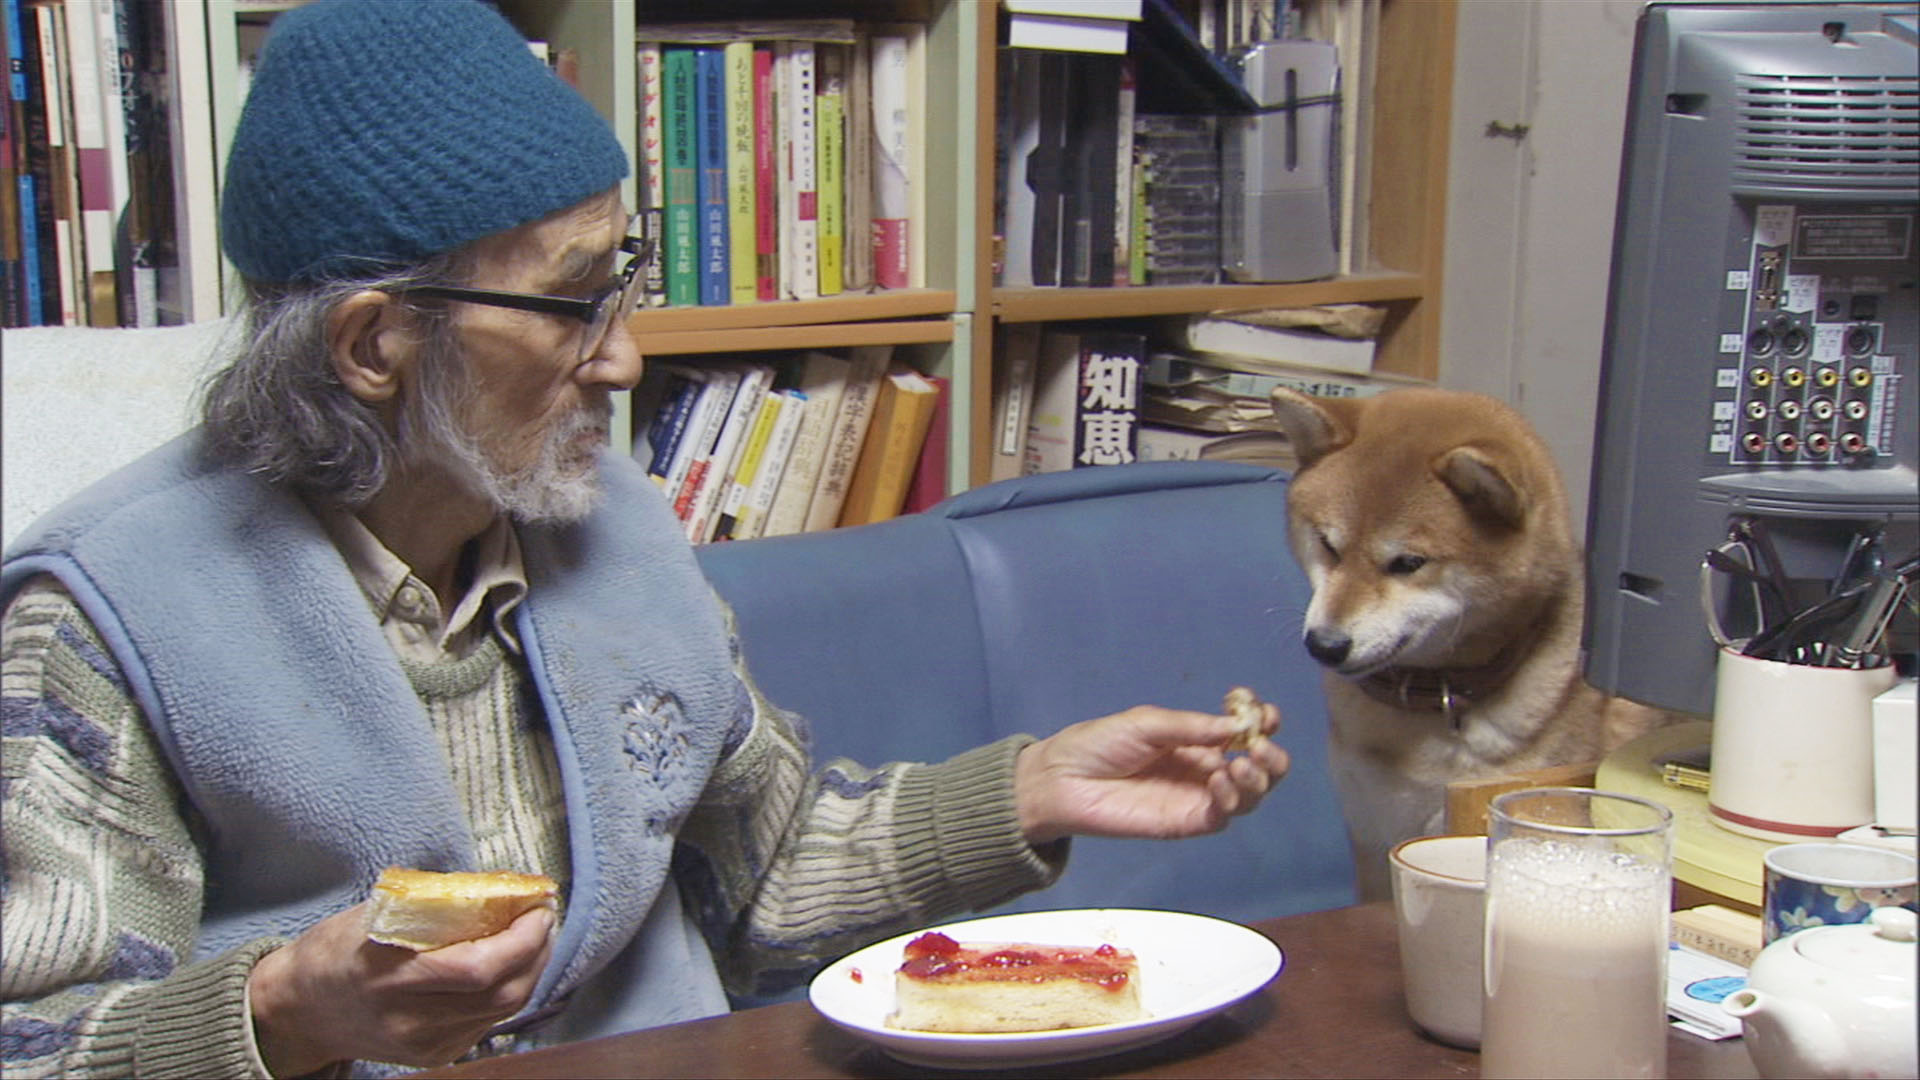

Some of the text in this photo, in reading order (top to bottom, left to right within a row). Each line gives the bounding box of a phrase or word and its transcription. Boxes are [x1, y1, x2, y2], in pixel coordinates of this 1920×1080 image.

[676, 207, 691, 273] 山田風太郎
[709, 208, 724, 273] 山田風太郎
[1079, 352, 1140, 465] 知恵
